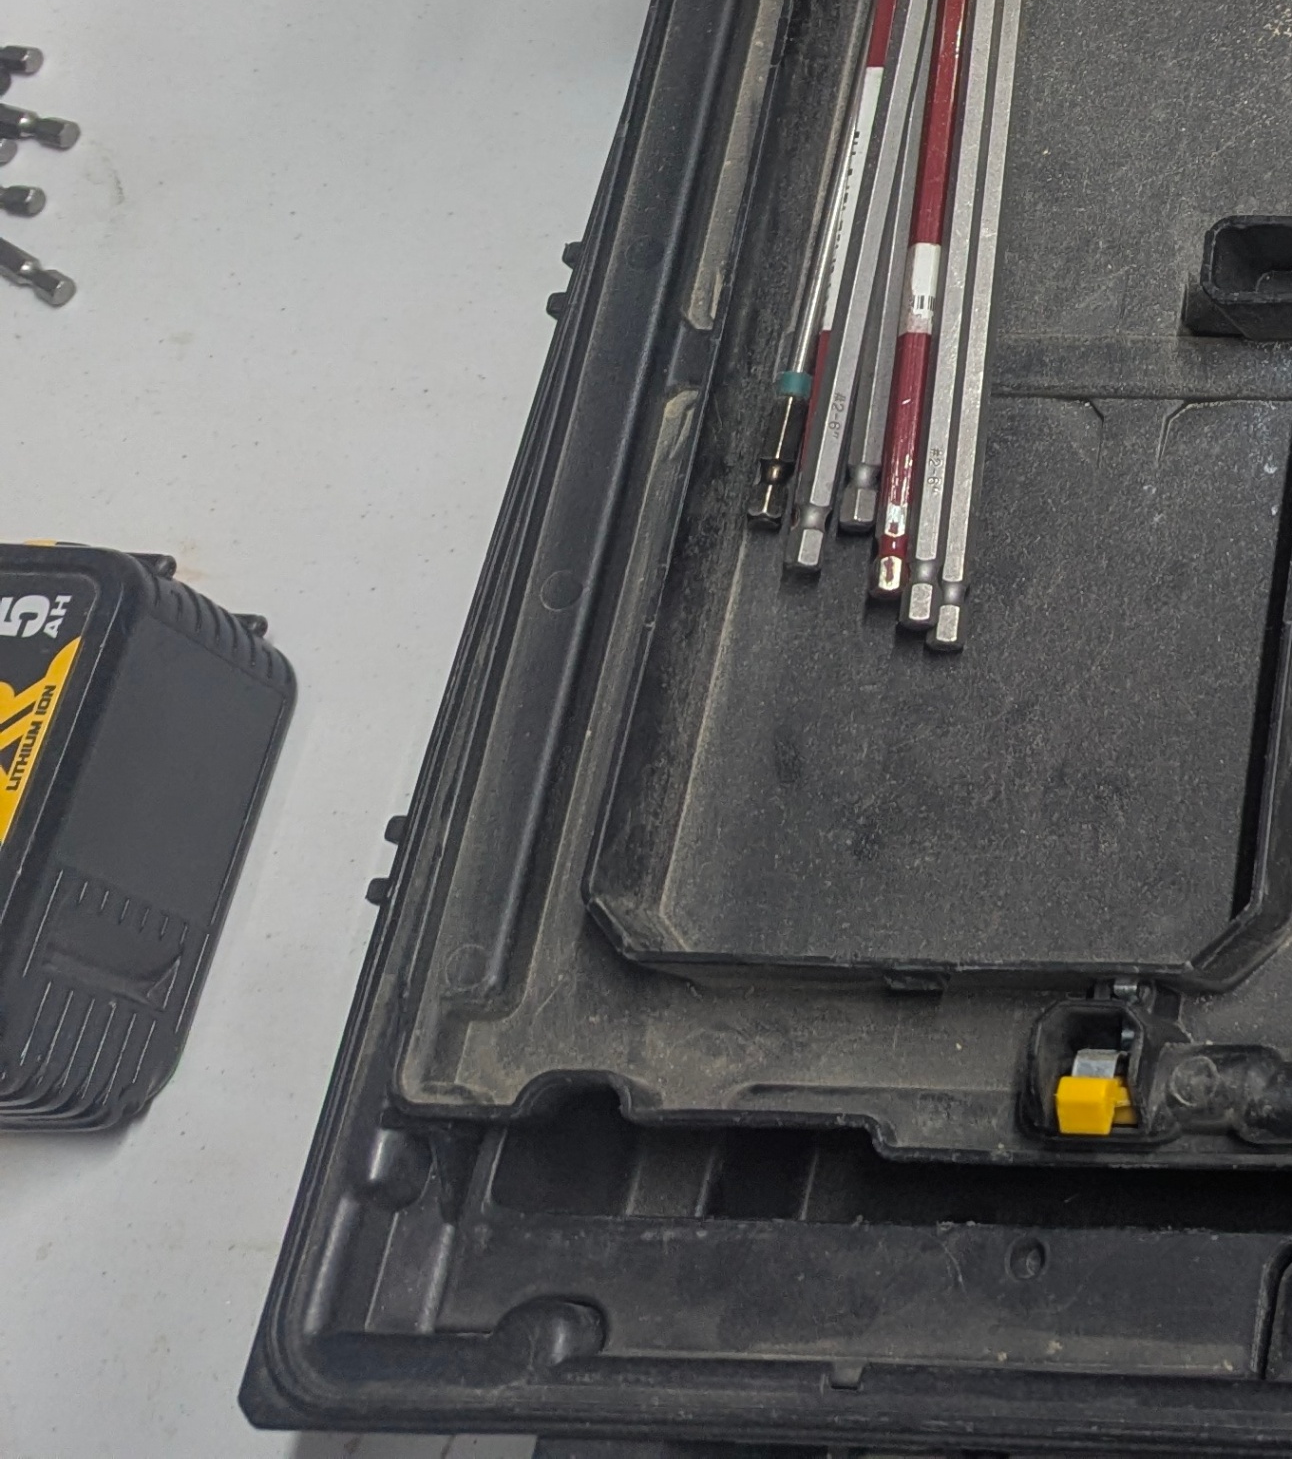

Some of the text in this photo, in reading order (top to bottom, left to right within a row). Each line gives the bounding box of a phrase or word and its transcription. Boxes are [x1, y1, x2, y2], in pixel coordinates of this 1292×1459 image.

[828, 392, 846, 439] #2-6"
[927, 447, 943, 497] #2-6"
[6, 720, 43, 791] LITHIUM
[35, 684, 56, 716] ION
